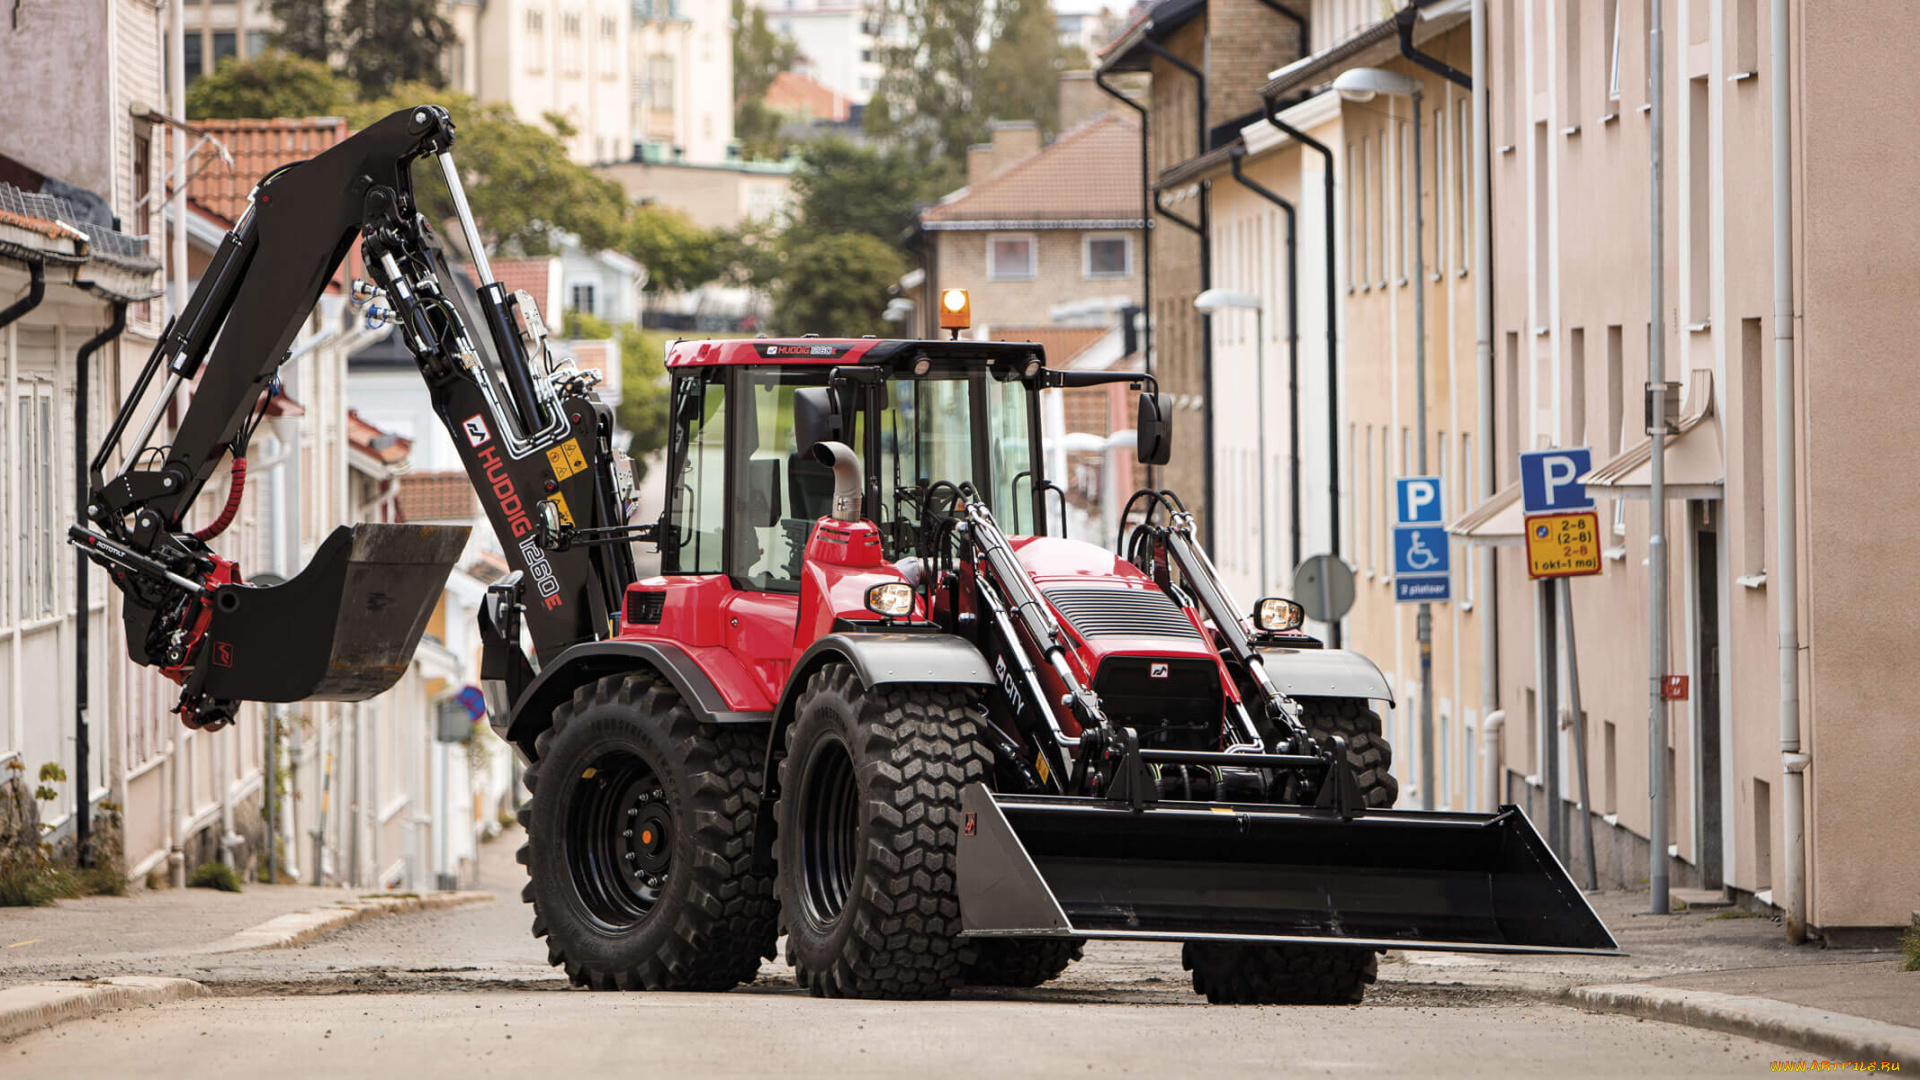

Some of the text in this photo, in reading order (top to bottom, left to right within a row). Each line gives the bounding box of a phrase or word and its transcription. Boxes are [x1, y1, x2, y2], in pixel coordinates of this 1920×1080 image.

[778, 346, 810, 354] HUDDIG
[1543, 456, 1576, 505] P
[478, 446, 532, 538] HUDDIG
[1407, 481, 1435, 520] P
[1561, 519, 1586, 531] 2-8
[1558, 531, 1591, 545] (2-8)
[96, 541, 126, 557] ROTOTILT
[1564, 545, 1588, 557] 2-8
[1534, 561, 1539, 570] 1
[1575, 557, 1596, 569] maj
[1004, 673, 1025, 715] CITY
